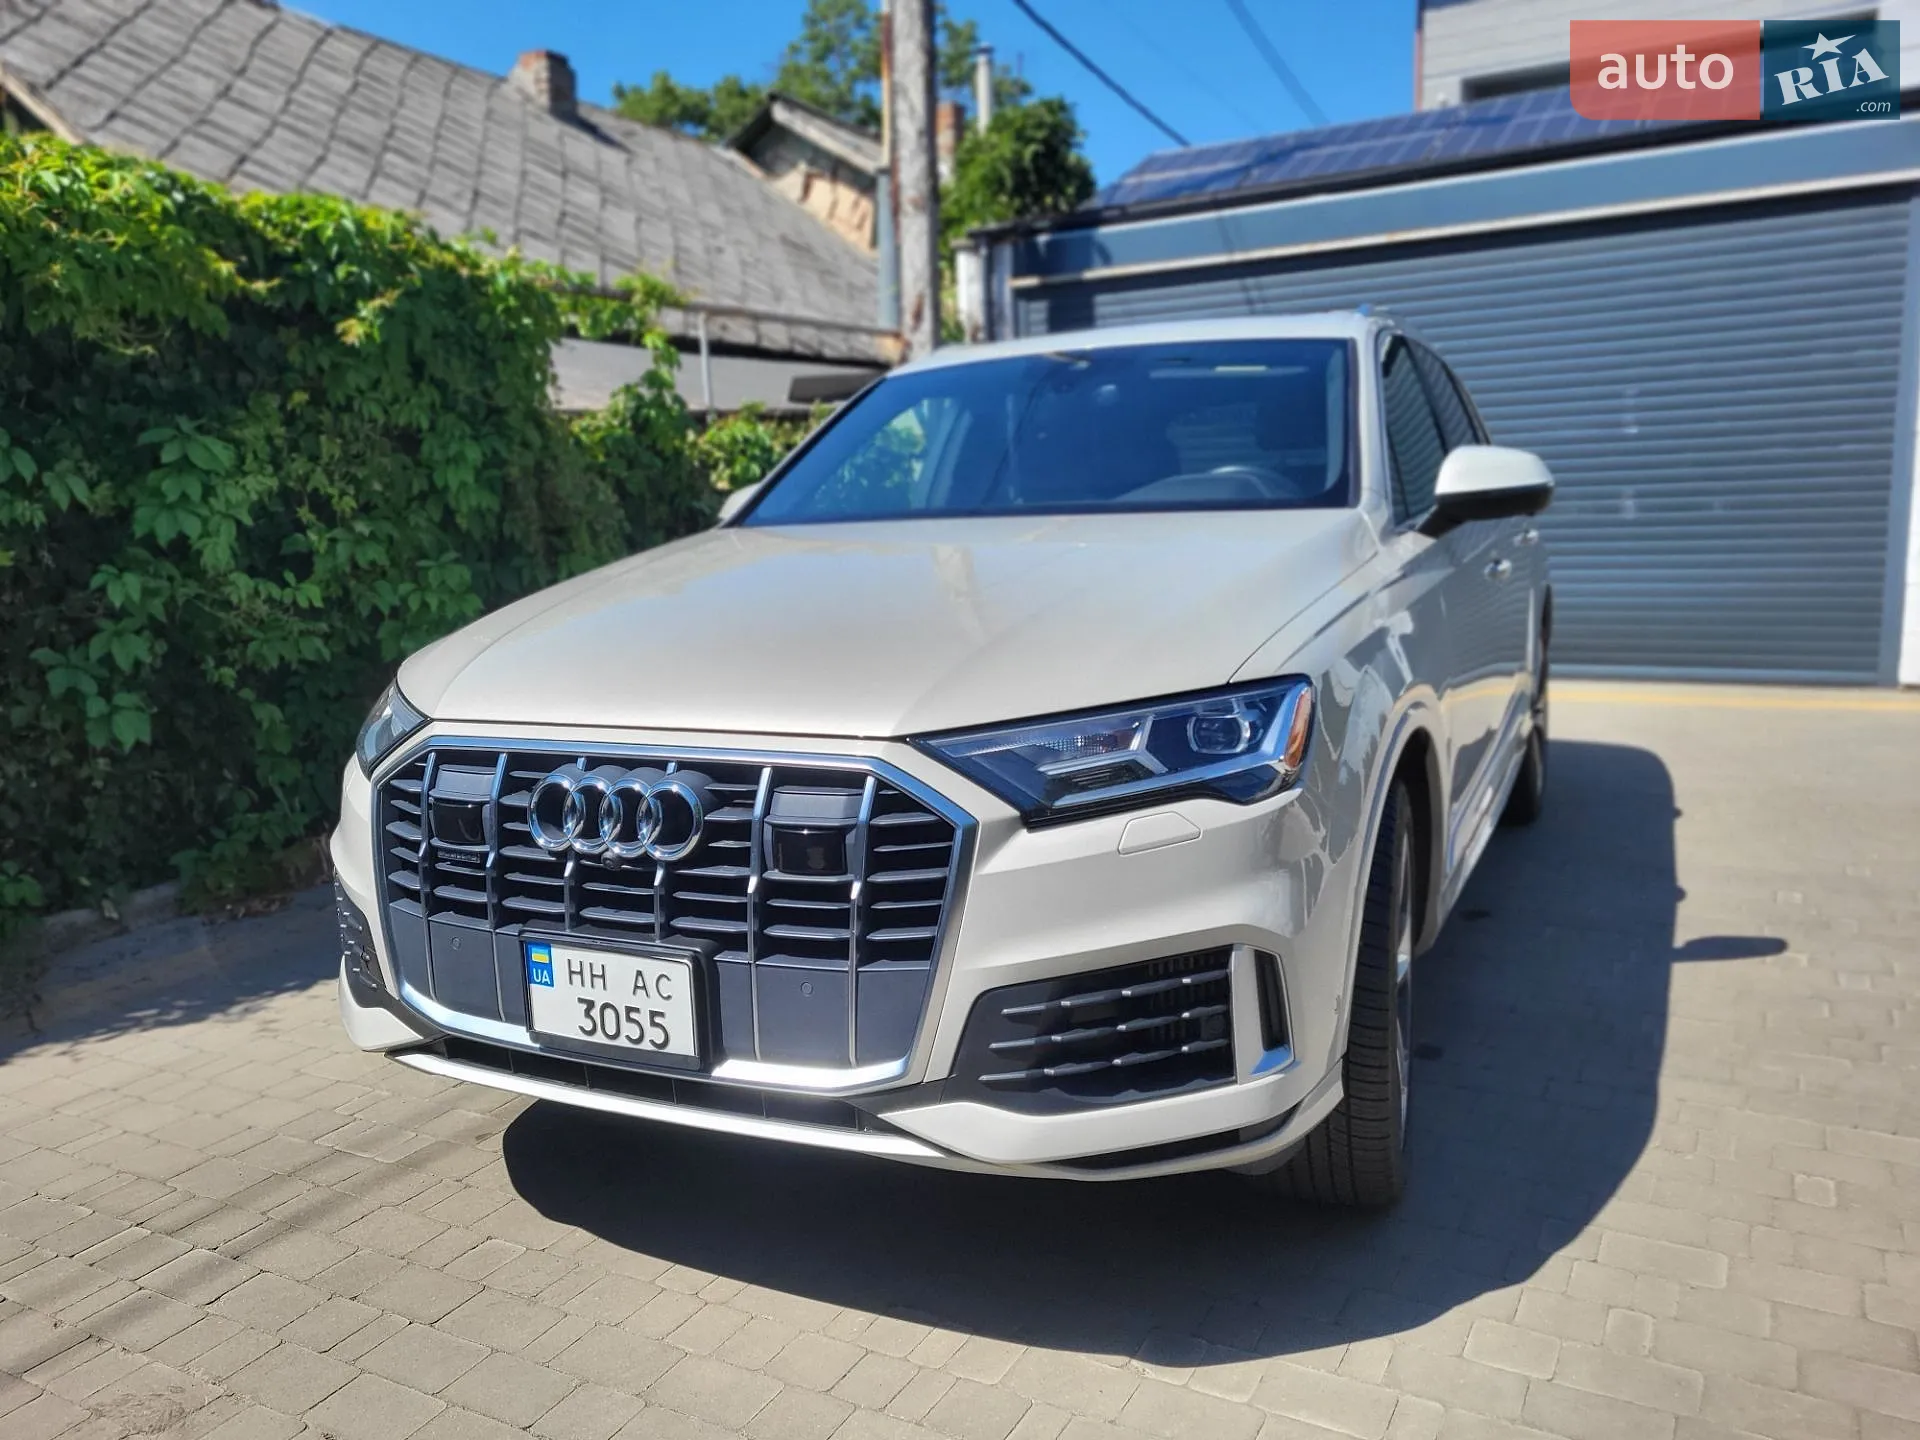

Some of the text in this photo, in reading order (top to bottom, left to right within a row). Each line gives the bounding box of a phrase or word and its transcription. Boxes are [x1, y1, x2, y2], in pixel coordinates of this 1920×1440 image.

[533, 967, 551, 984] UA
[567, 958, 672, 999] HH AC
[577, 997, 670, 1049] 3055
